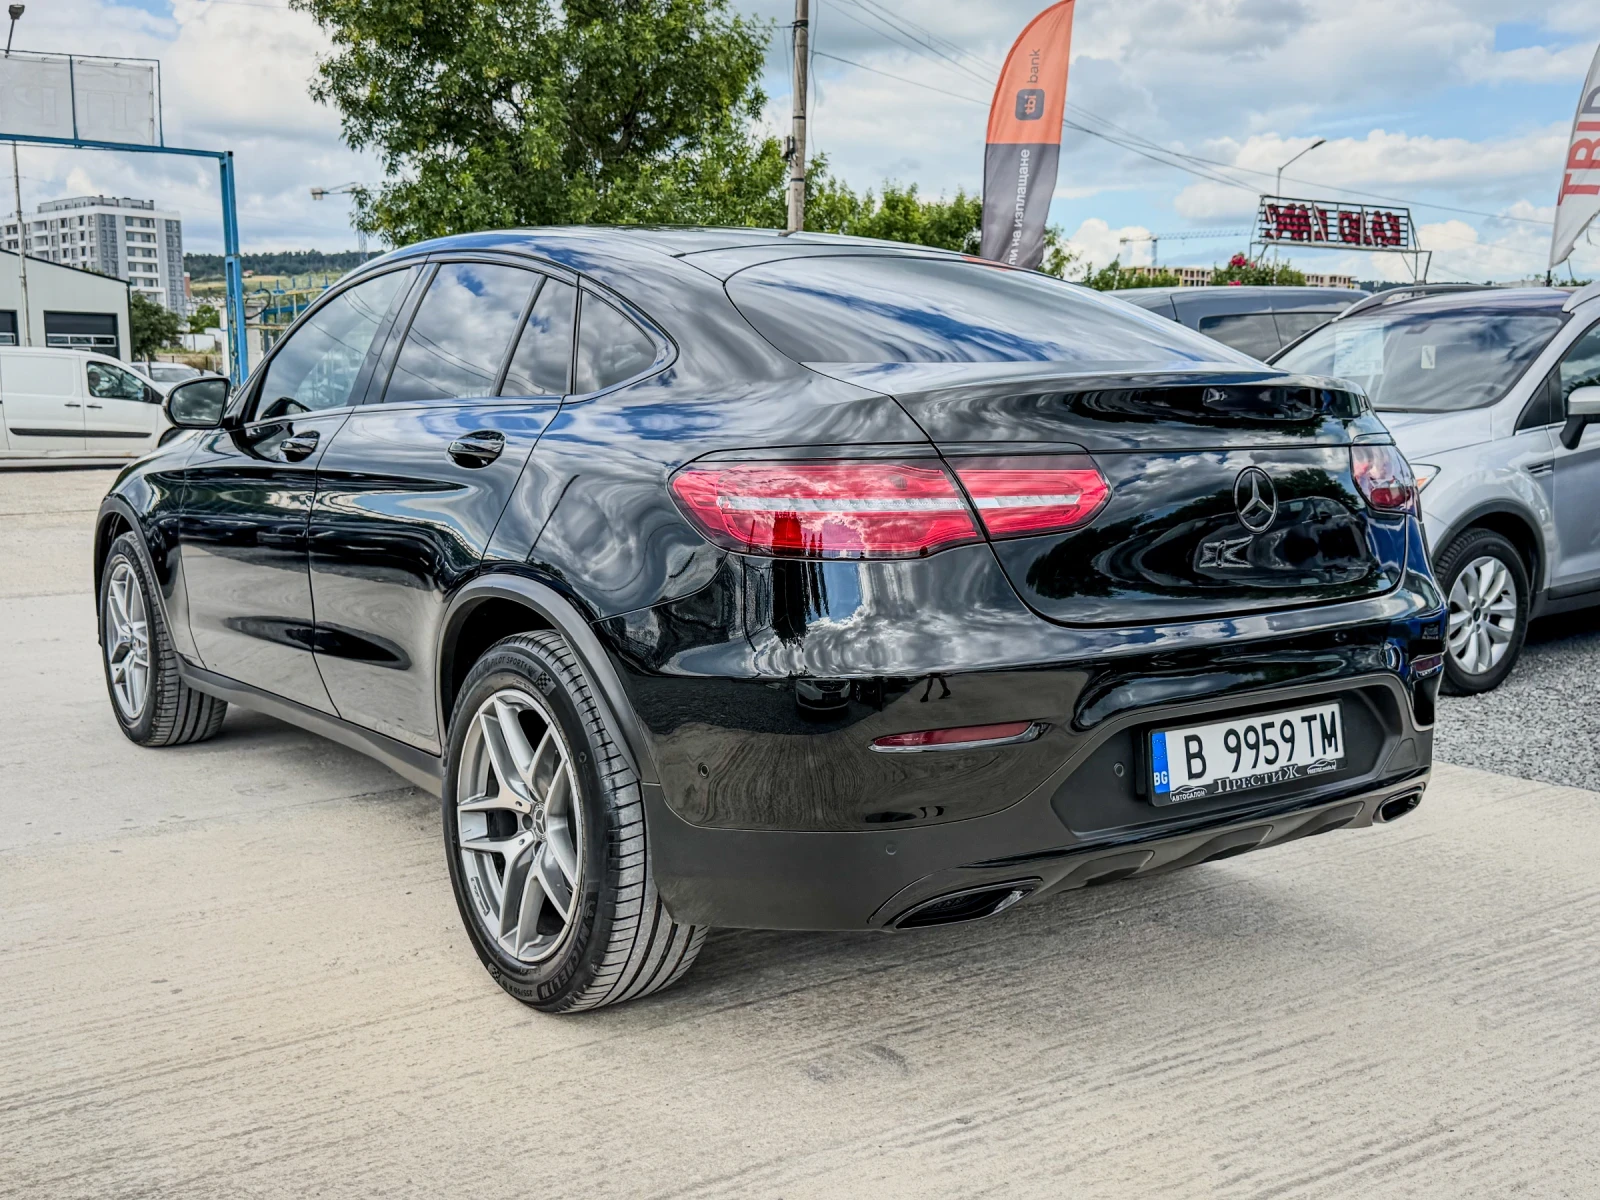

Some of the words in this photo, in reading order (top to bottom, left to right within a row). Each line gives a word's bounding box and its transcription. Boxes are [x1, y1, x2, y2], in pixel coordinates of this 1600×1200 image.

[1027, 48, 1041, 84] bank
[1024, 95, 1037, 115] tbi
[1014, 149, 1031, 228] изплащане
[1011, 230, 1022, 247] на
[1184, 734, 1207, 781] B
[1223, 719, 1296, 773] 9959
[1300, 711, 1339, 758] TM
[1154, 771, 1168, 786] BG
[1172, 790, 1206, 802] АВТОСАЛОН
[1213, 765, 1302, 794] ПРЕСТИЖ
